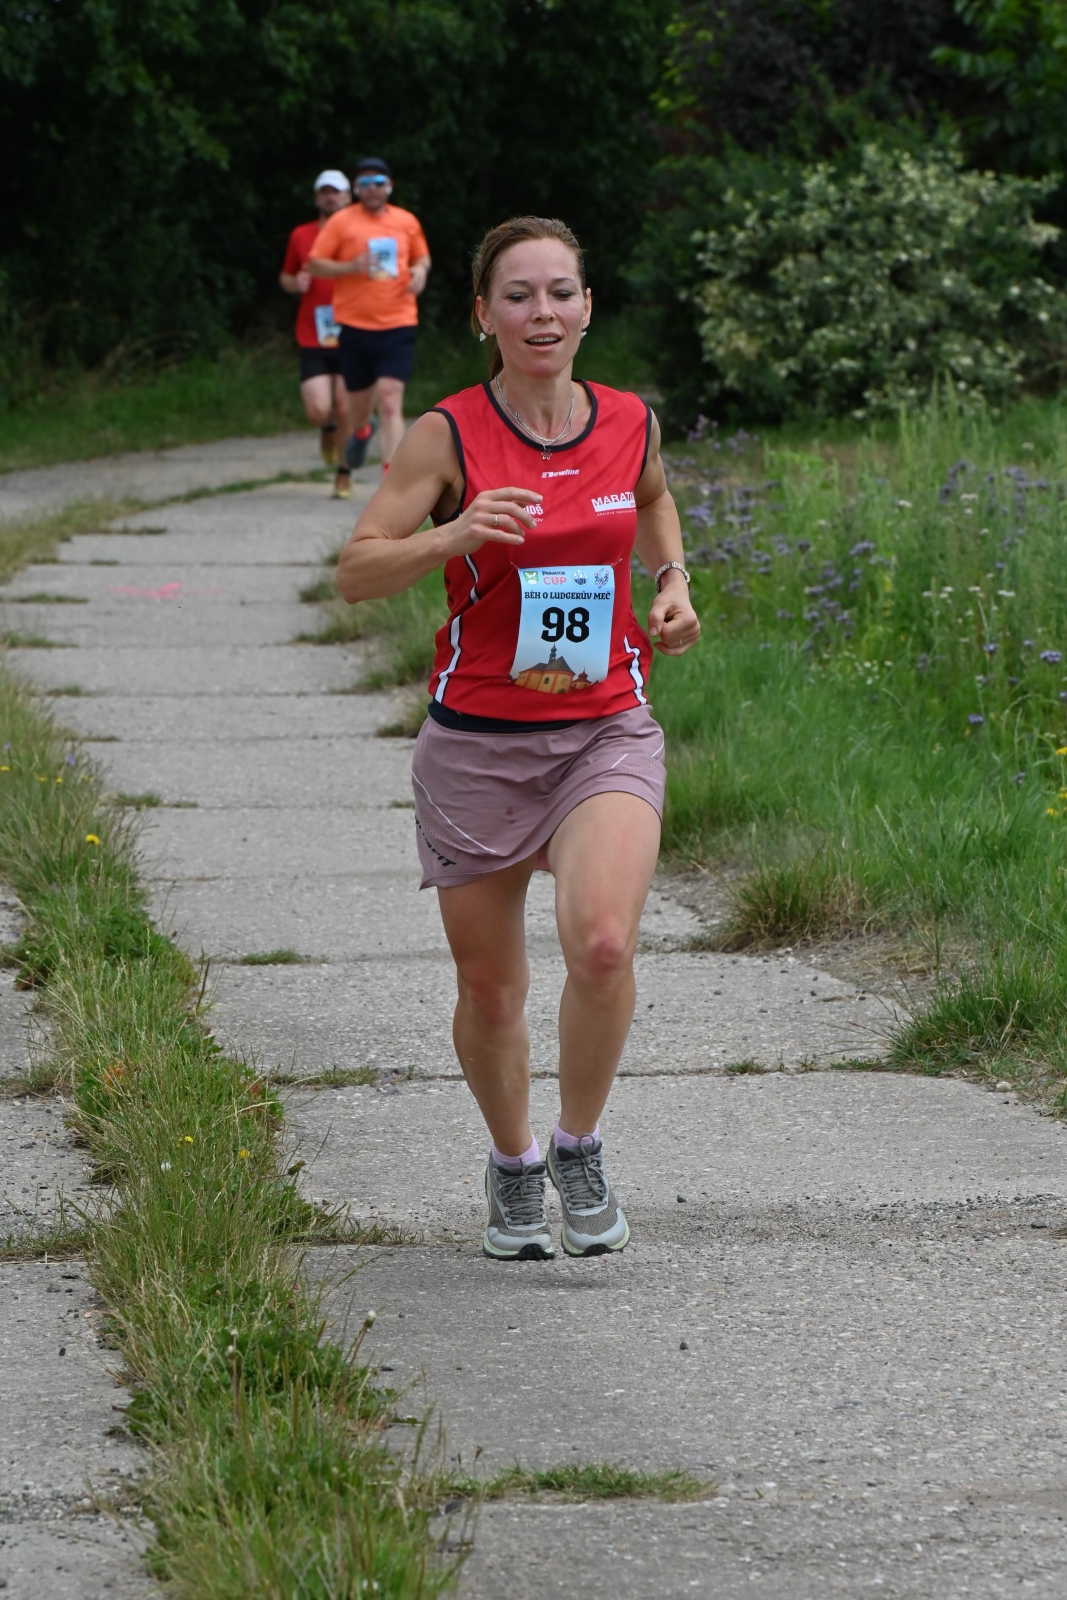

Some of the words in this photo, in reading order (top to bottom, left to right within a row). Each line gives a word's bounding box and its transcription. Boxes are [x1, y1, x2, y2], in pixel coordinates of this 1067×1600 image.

[543, 576, 567, 585] CUP
[593, 591, 611, 600] MEČ
[541, 606, 590, 643] 98
